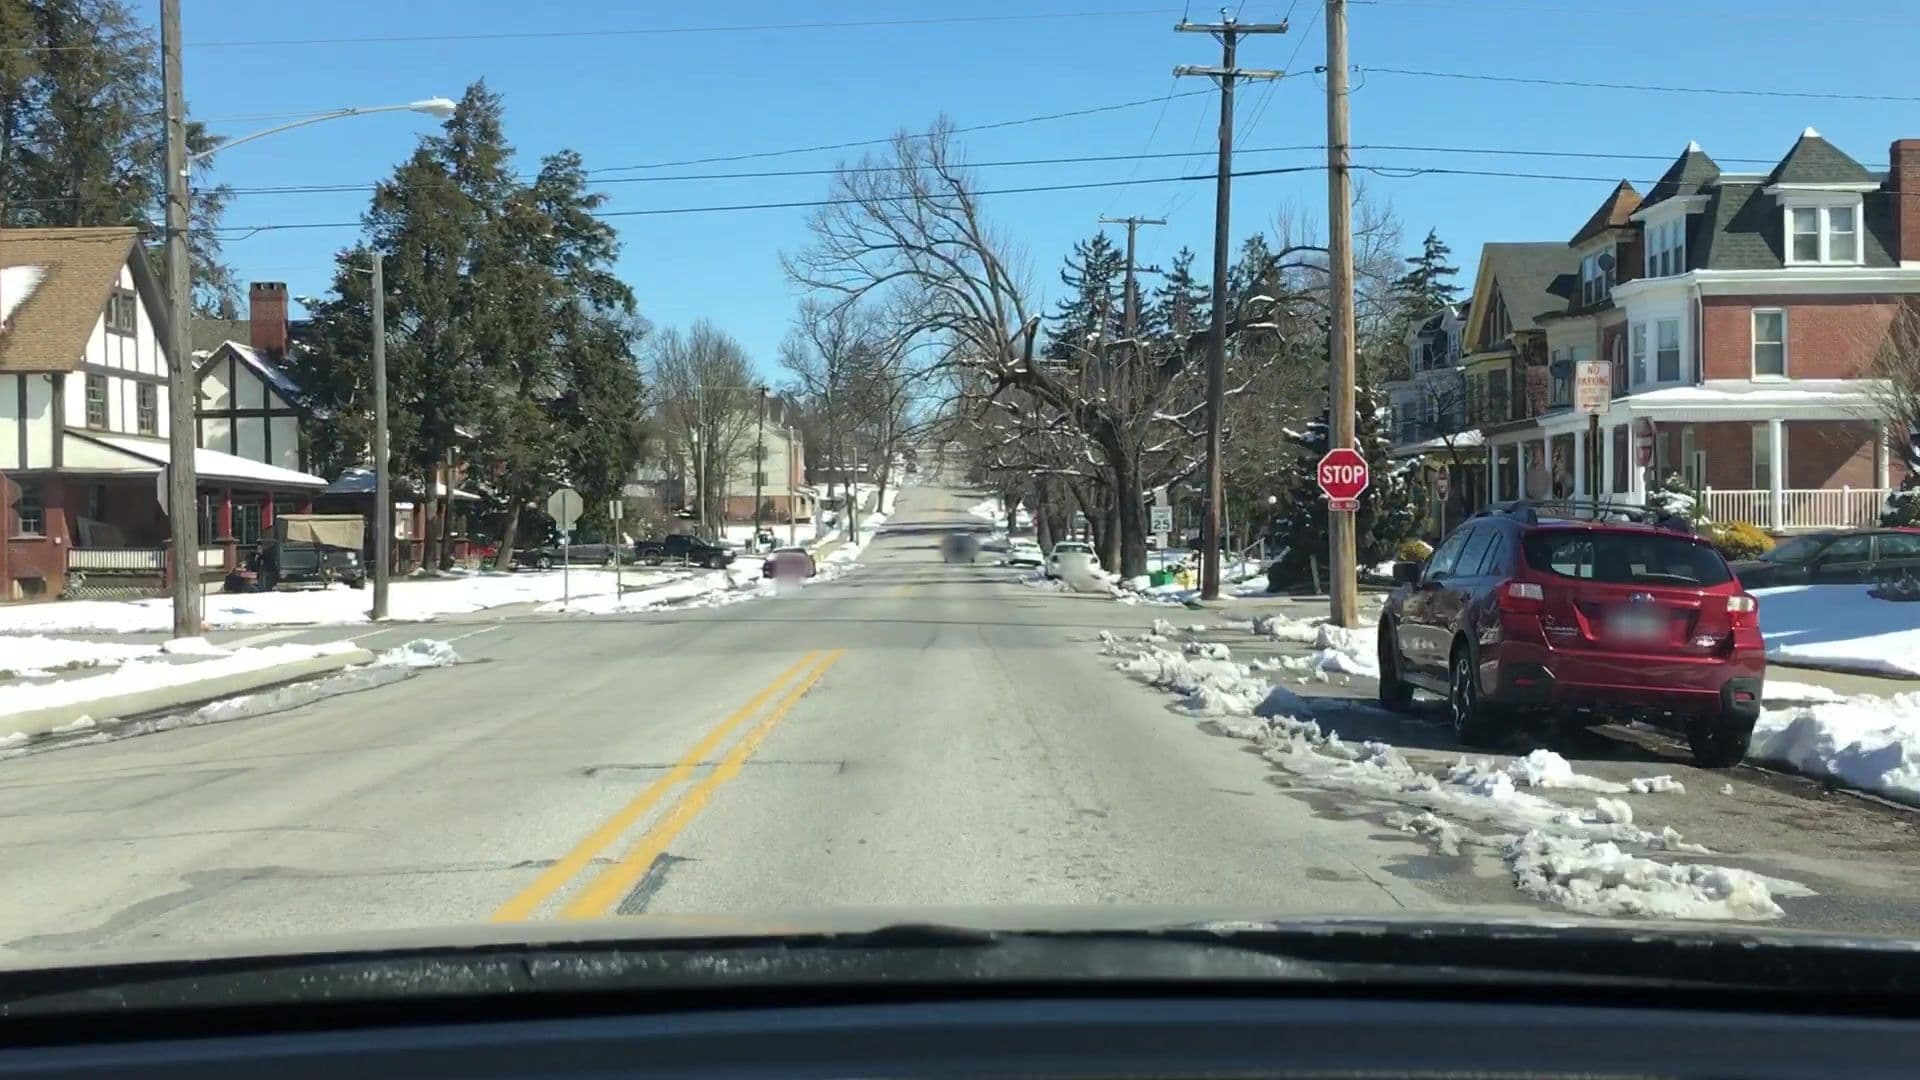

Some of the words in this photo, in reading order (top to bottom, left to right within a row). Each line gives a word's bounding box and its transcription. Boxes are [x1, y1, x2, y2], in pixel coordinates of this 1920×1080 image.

[1587, 366, 1600, 375] NO
[1578, 376, 1609, 385] PARKING
[1322, 465, 1365, 484] STOP
[1153, 520, 1170, 530] 25
